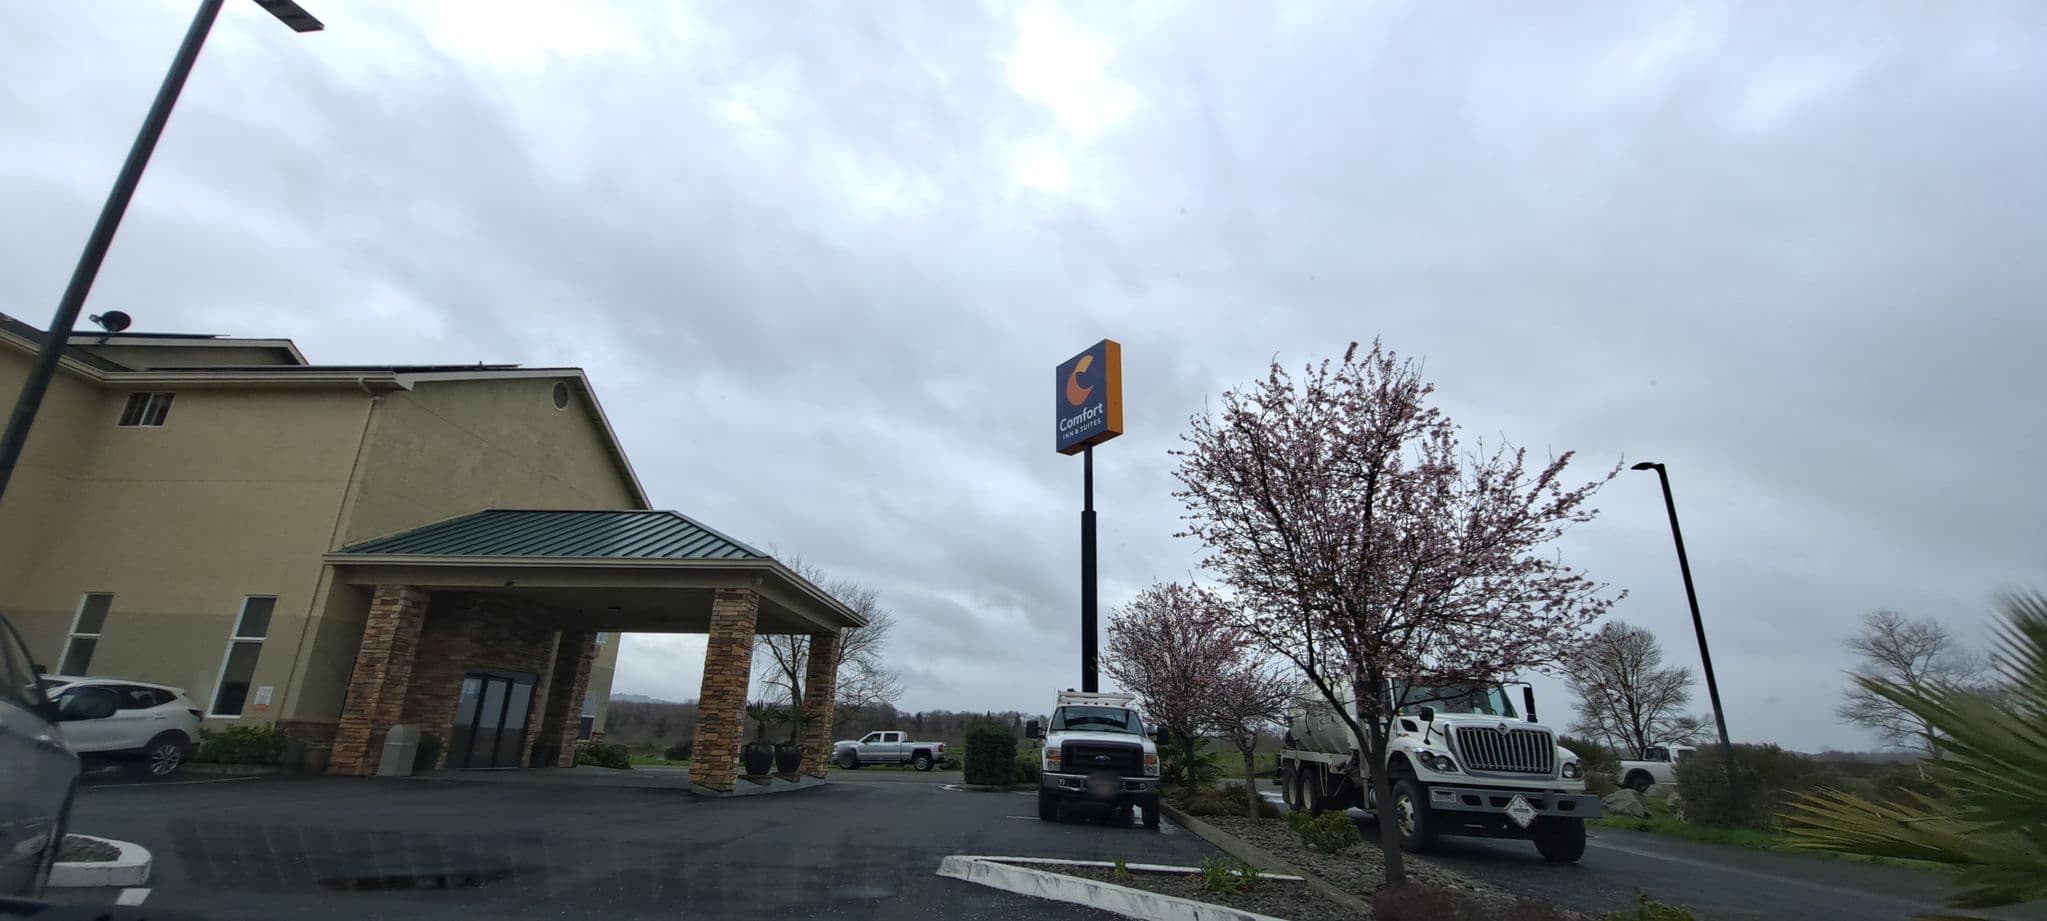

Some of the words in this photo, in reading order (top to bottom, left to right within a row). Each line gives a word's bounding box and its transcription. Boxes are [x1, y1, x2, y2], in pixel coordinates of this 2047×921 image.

[1060, 402, 1103, 431] Comfort
[1062, 430, 1074, 440] INN
[1079, 418, 1102, 432] SUITES
